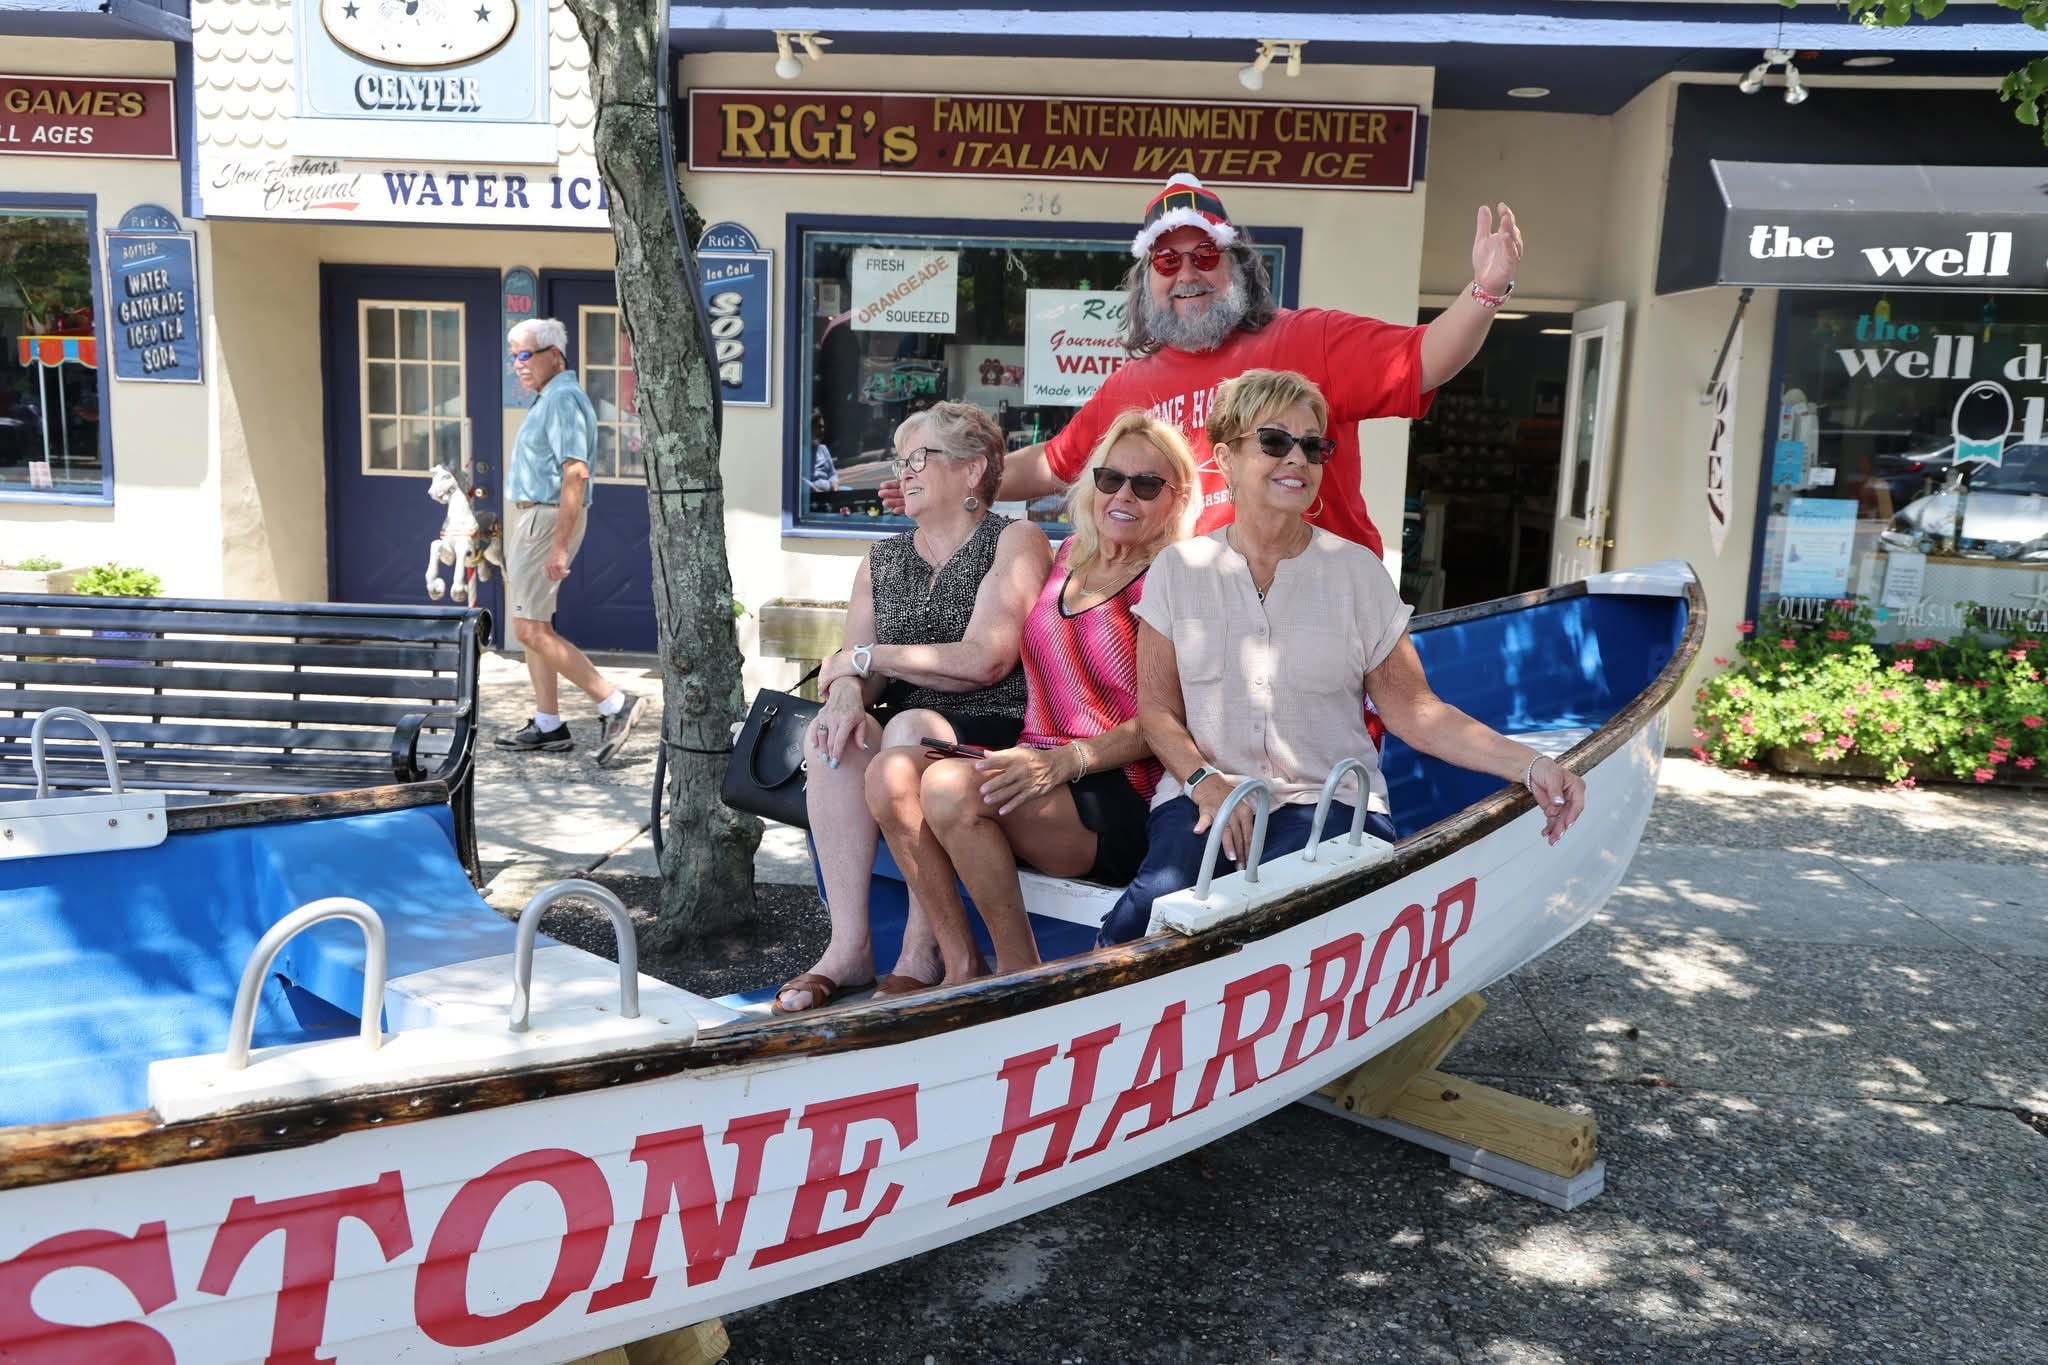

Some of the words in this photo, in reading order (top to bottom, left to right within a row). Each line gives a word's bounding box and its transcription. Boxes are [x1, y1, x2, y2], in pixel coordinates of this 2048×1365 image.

[5, 88, 145, 118] GAMES
[356, 73, 482, 111] CENTER
[32, 126, 94, 144] AGES
[720, 104, 918, 163] RiGi's
[933, 97, 1025, 134] FAMILY
[1046, 101, 1264, 141] ENTERTAINMENT
[1275, 108, 1387, 144] CENTER
[952, 141, 1109, 171] ITALIAN
[1132, 146, 1282, 177] WATER
[1301, 152, 1373, 179] ICE
[384, 172, 529, 208] WATER
[866, 258, 905, 271] FRESH
[1748, 224, 1834, 259] the
[1861, 231, 2013, 277] well
[127, 269, 170, 297] WATER
[707, 268, 723, 280] Ice
[726, 263, 750, 277] Cold
[505, 293, 532, 313] NO
[858, 256, 950, 324] ORANGEADE
[120, 291, 185, 324] GATORADE
[886, 310, 950, 324] SQUEEZED
[129, 323, 158, 349] ICED
[161, 317, 184, 343] TEA
[709, 291, 745, 384] SODA
[1855, 314, 1920, 343] the
[143, 345, 178, 374] SODA
[1056, 354, 1134, 375] WATE
[1835, 335, 1974, 379] well
[869, 371, 938, 395] ATM
[1777, 596, 1827, 622] OLIVE
[0, 1083, 919, 1365] STONE
[947, 877, 1477, 1208] HARBOR
